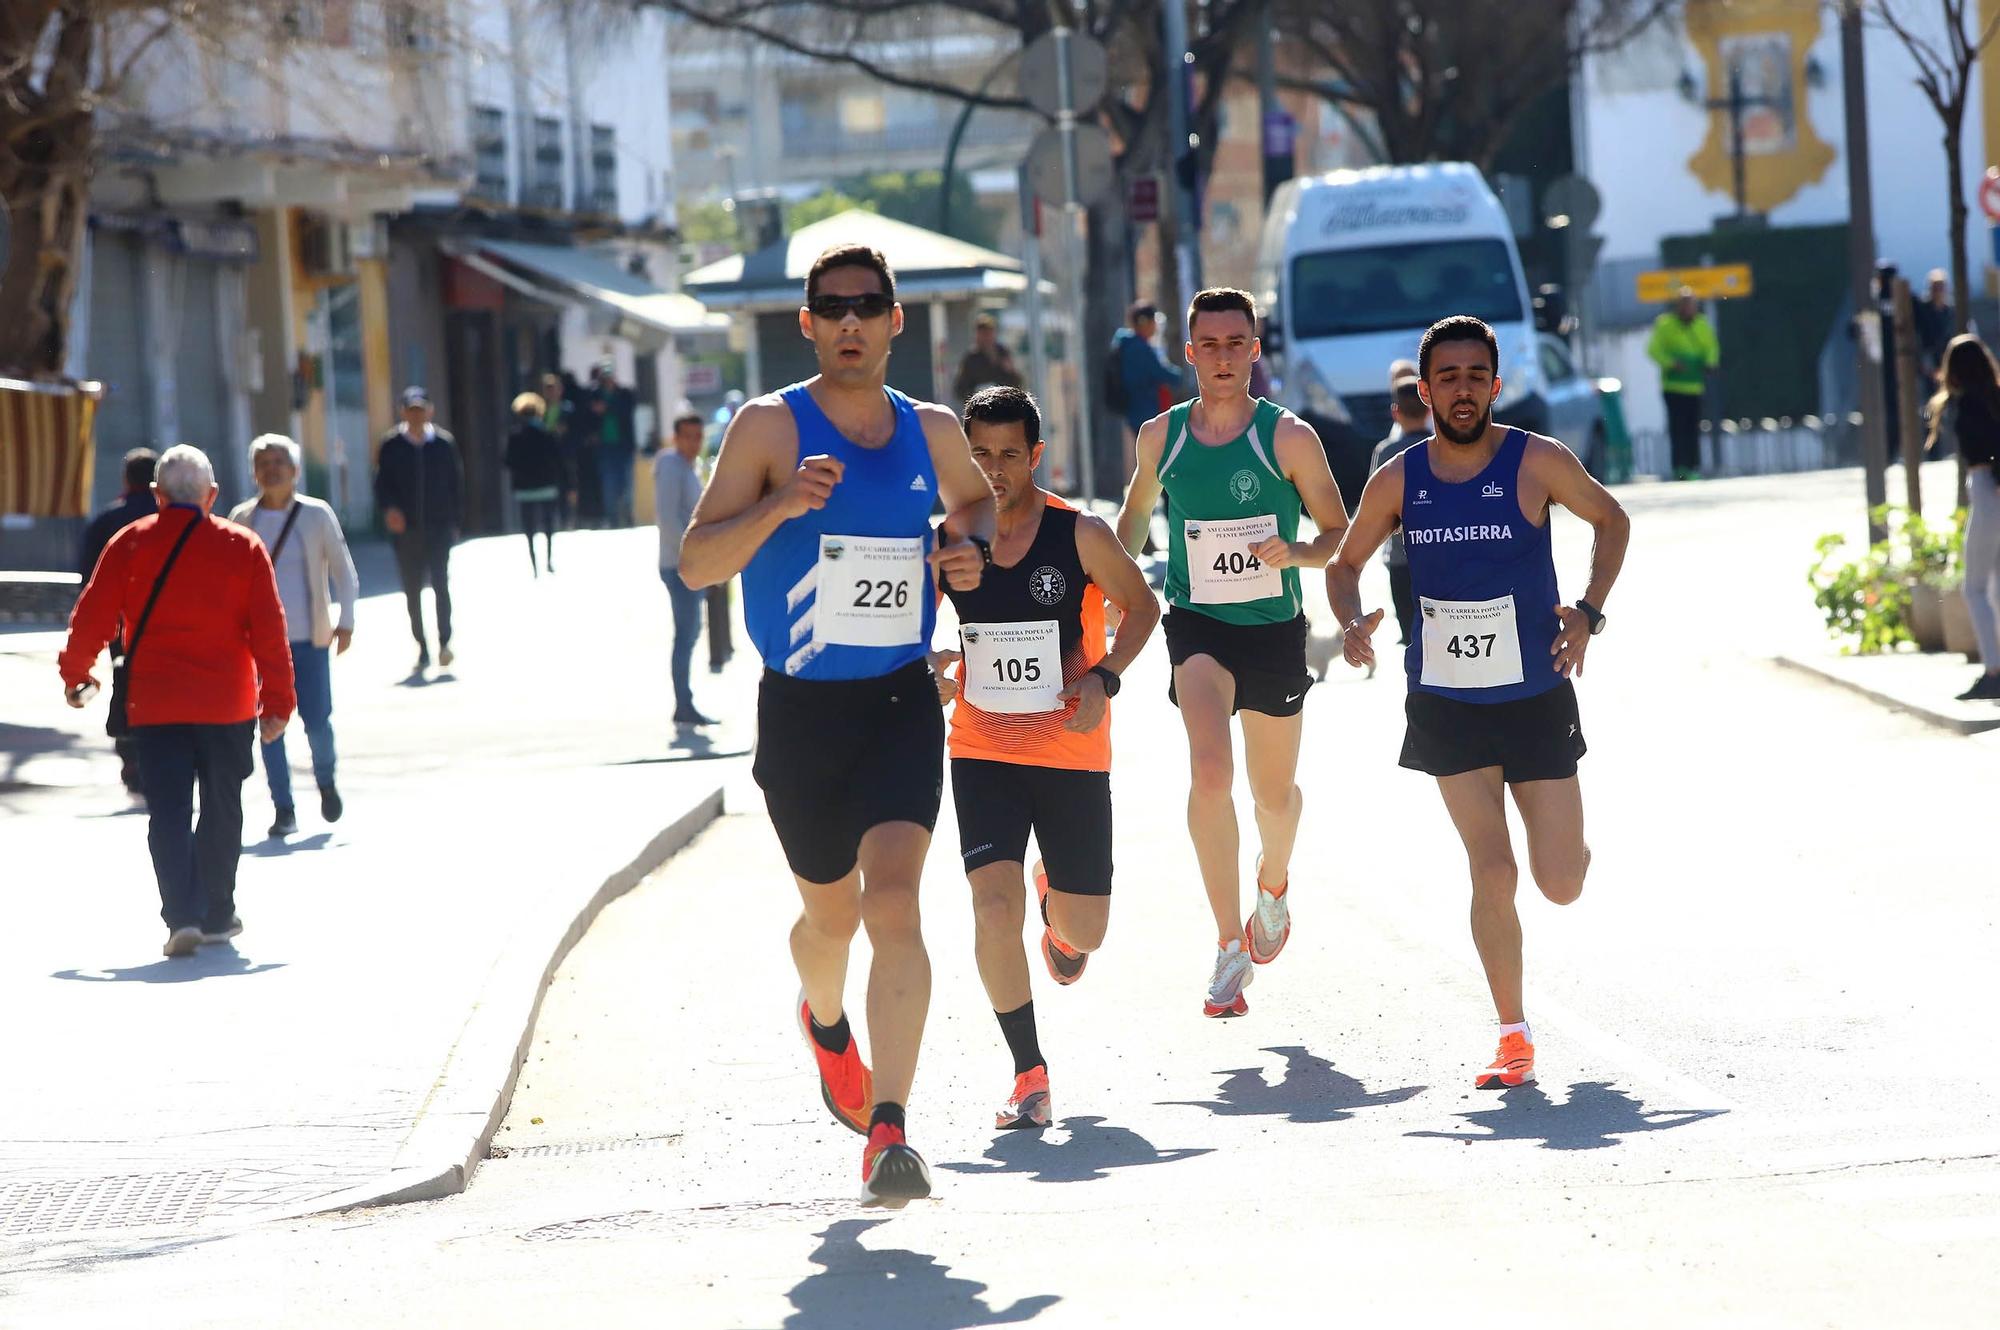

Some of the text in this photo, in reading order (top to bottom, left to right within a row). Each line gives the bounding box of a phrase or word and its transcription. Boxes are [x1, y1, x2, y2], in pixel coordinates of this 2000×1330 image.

[1217, 525, 1245, 533] CARRERA
[1245, 522, 1272, 530] POPULAR
[1239, 529, 1264, 538] ROMANO
[1408, 525, 1512, 545] TROTASIERRA
[1213, 552, 1261, 574] 404
[853, 579, 908, 608] 226
[1451, 606, 1480, 614] CARRERA
[1481, 603, 1509, 613] POPULAR
[1473, 611, 1501, 620] ROMANO
[1025, 627, 1054, 635] POPULAR
[1446, 633, 1497, 659] 437
[993, 657, 1040, 682] 105
